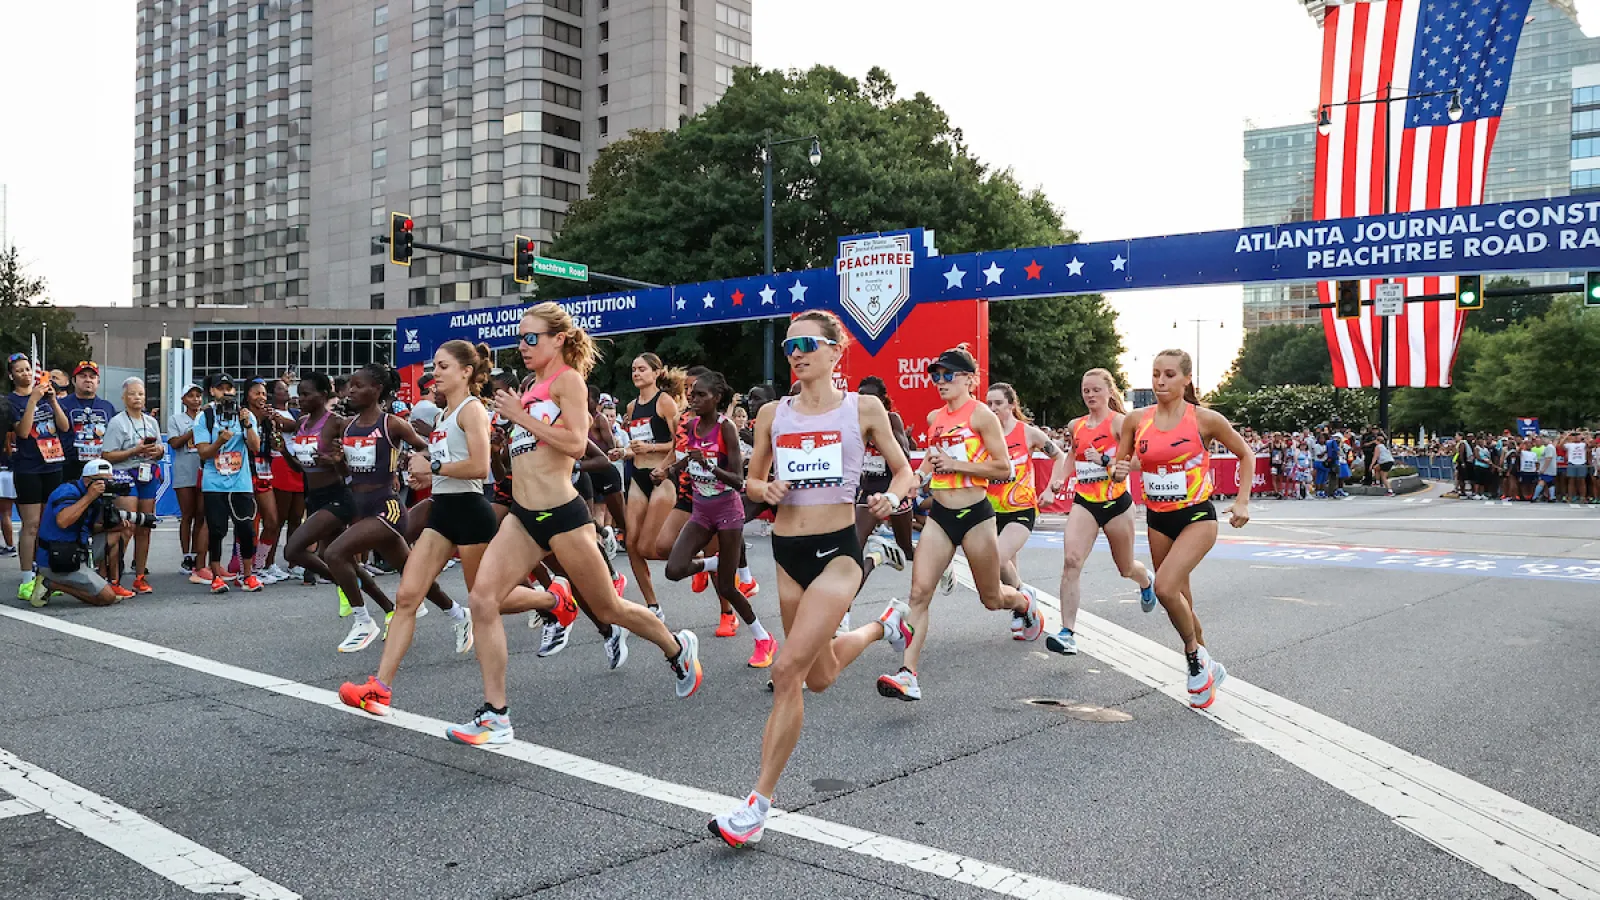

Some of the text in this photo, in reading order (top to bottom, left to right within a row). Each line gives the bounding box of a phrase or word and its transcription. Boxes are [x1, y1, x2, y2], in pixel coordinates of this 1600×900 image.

[1235, 227, 1345, 253] ATLANTA
[1307, 228, 1600, 269] PEACHTREE ROAD RA
[534, 260, 585, 277] Peachtree Road
[839, 253, 912, 271] PEACHTREE
[450, 312, 493, 328] ATLANTA
[899, 373, 932, 389] CITY
[787, 458, 830, 473] Carrie
[1148, 481, 1179, 490] Kassie
